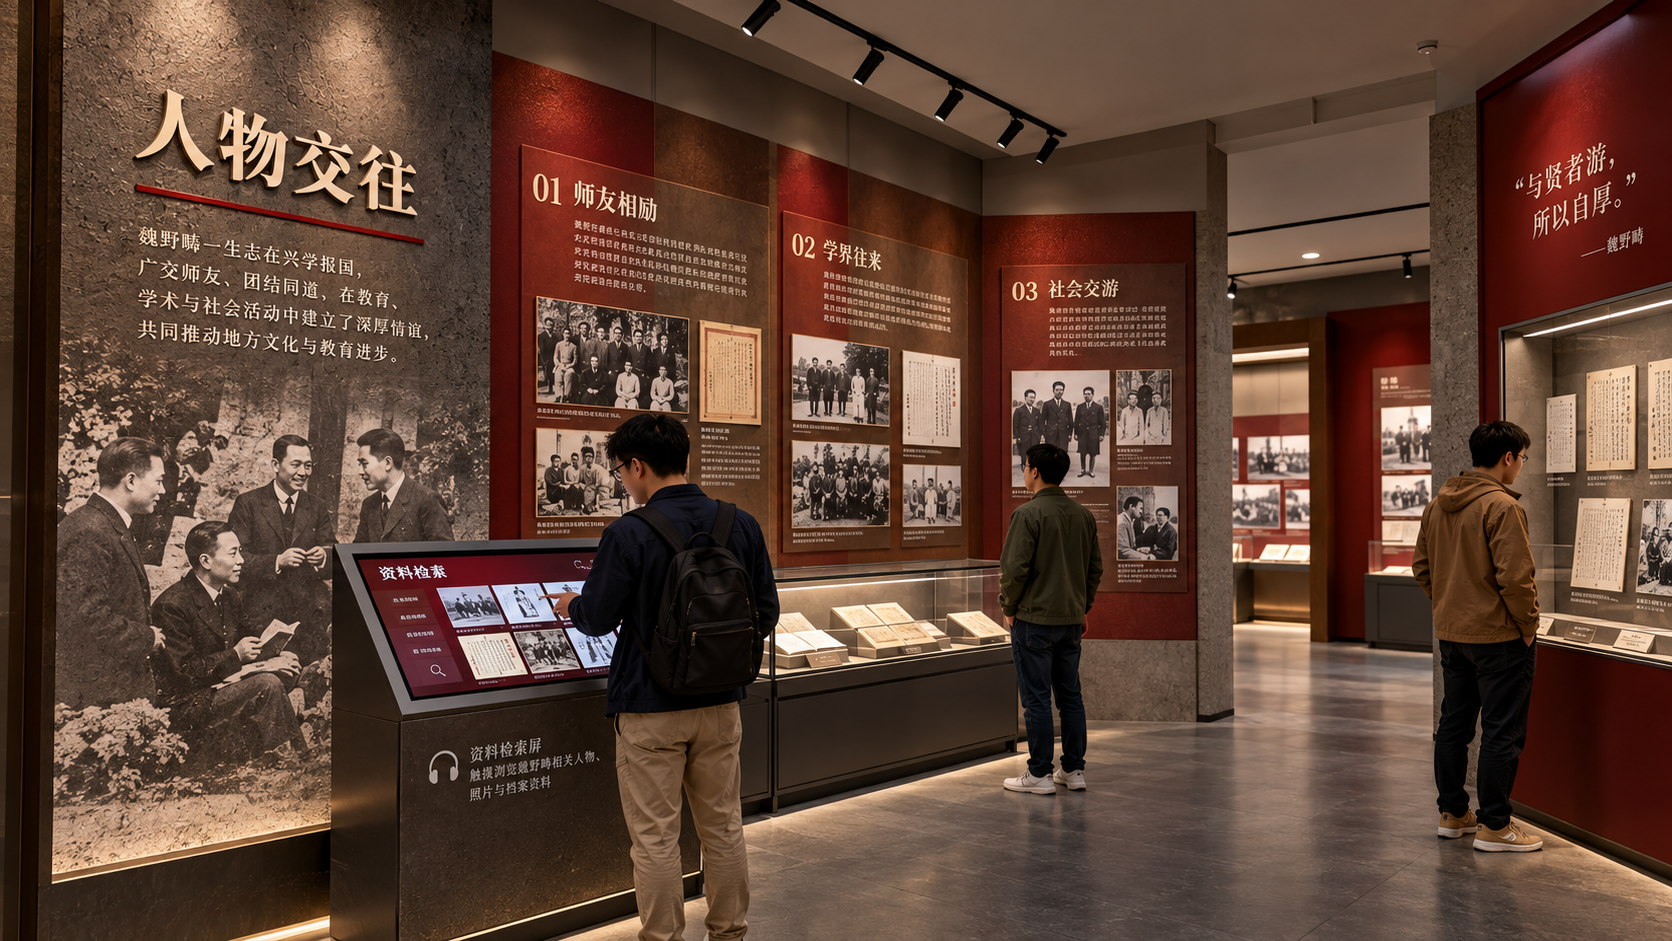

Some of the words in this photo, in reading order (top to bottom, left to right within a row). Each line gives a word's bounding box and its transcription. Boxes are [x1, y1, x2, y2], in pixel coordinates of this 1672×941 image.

[134, 89, 418, 216] 人物交往
[532, 173, 562, 205] 01
[574, 180, 657, 223] 师友相励
[792, 233, 816, 259] 02
[823, 239, 882, 272] 学界往来
[1011, 281, 1038, 302] 03
[1048, 278, 1119, 299] 社会交游
[138, 289, 430, 341] 学术与社会活动中建立了深厚情谊，
[138, 320, 399, 364] 共同推动地方文化与教育进步。
[378, 564, 448, 581] 资料检索
[470, 737, 542, 764] 资料检索屏
[469, 775, 551, 802] 照片与档案资料
